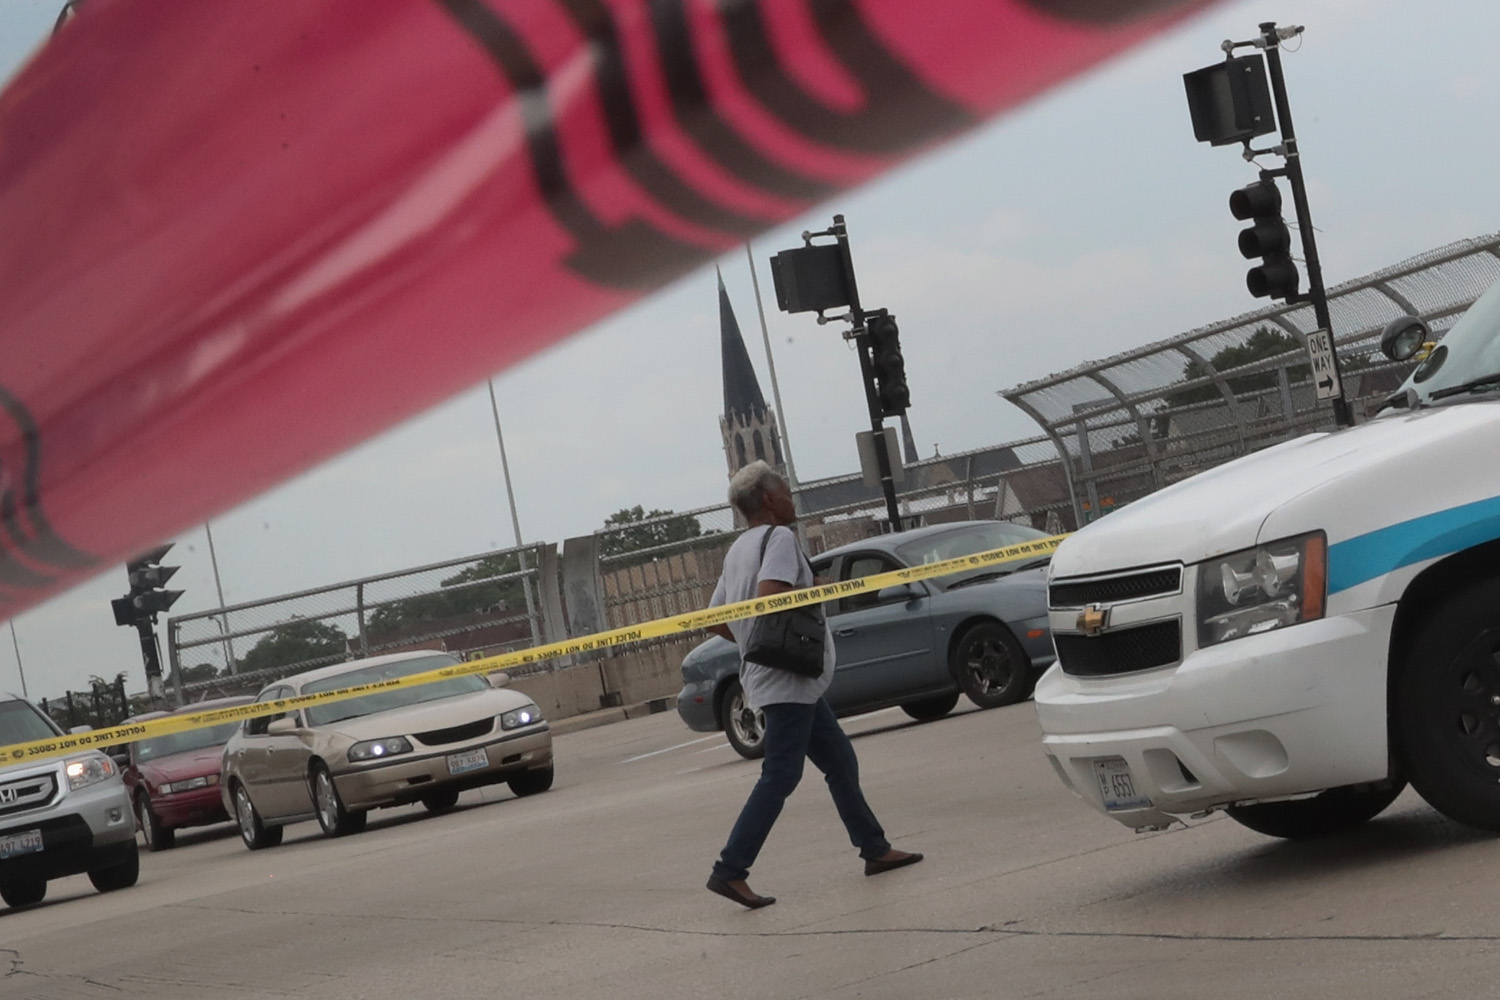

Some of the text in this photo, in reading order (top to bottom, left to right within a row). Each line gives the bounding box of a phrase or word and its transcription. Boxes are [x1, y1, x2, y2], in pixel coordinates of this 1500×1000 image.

[1310, 335, 1329, 354] ONE
[1312, 354, 1331, 372] WAY
[768, 579, 865, 609] POLICE LINE DO NOT CROSS
[537, 630, 642, 660] POLICE LINE DO NOT CROSS
[28, 725, 146, 756] POLICE LINE DO NOT CROSS
[1111, 773, 1136, 798] 6557
